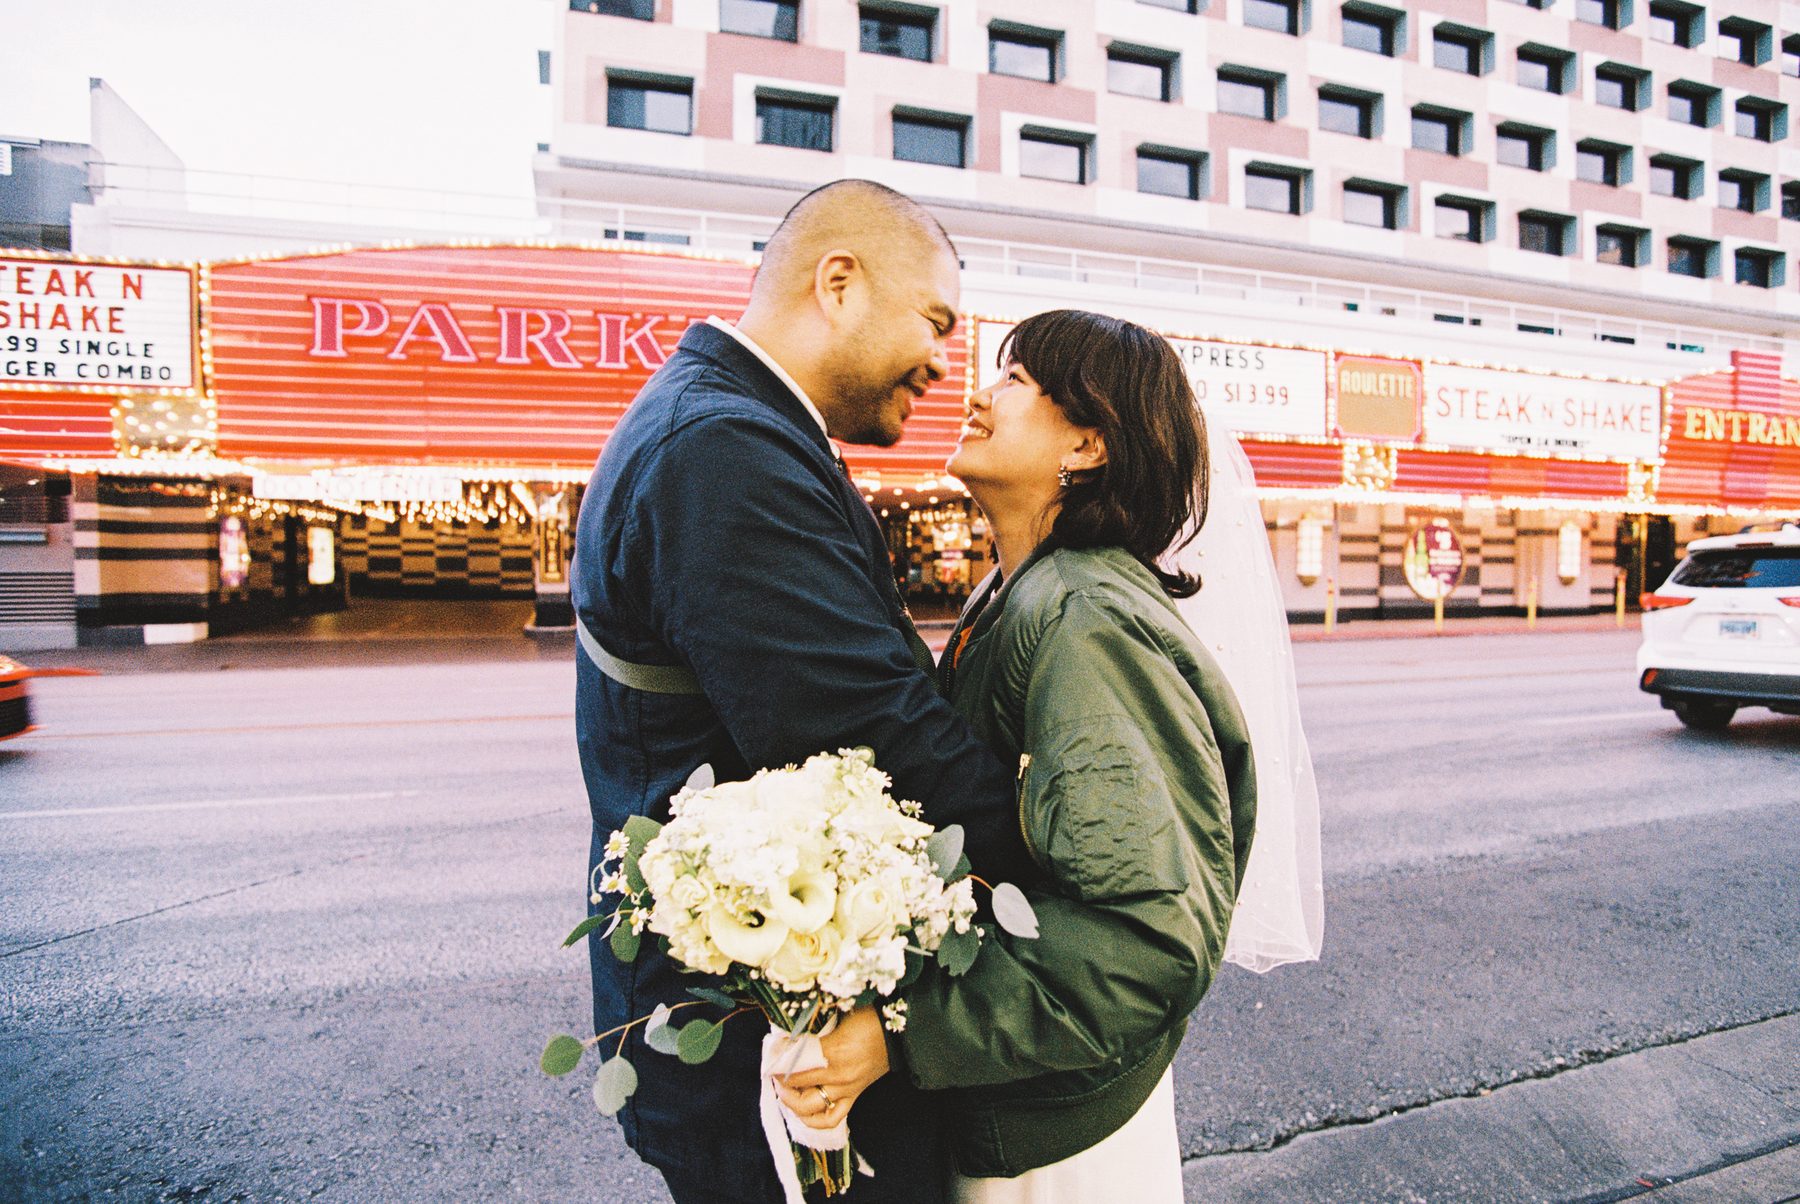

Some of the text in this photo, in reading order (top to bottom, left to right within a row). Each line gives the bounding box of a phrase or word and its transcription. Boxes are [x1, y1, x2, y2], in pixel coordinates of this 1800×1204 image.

[122, 273, 142, 300] N
[0, 301, 125, 333] SHAKE
[58, 339, 154, 358] SINGLE
[308, 297, 706, 369] PARK
[6, 360, 171, 381] GER COMBO
[1340, 369, 1413, 399] ROULETTE
[1436, 386, 1533, 425] STEAK
[1563, 397, 1653, 434] SHAKE
[1684, 406, 1800, 447] ENTRAN
